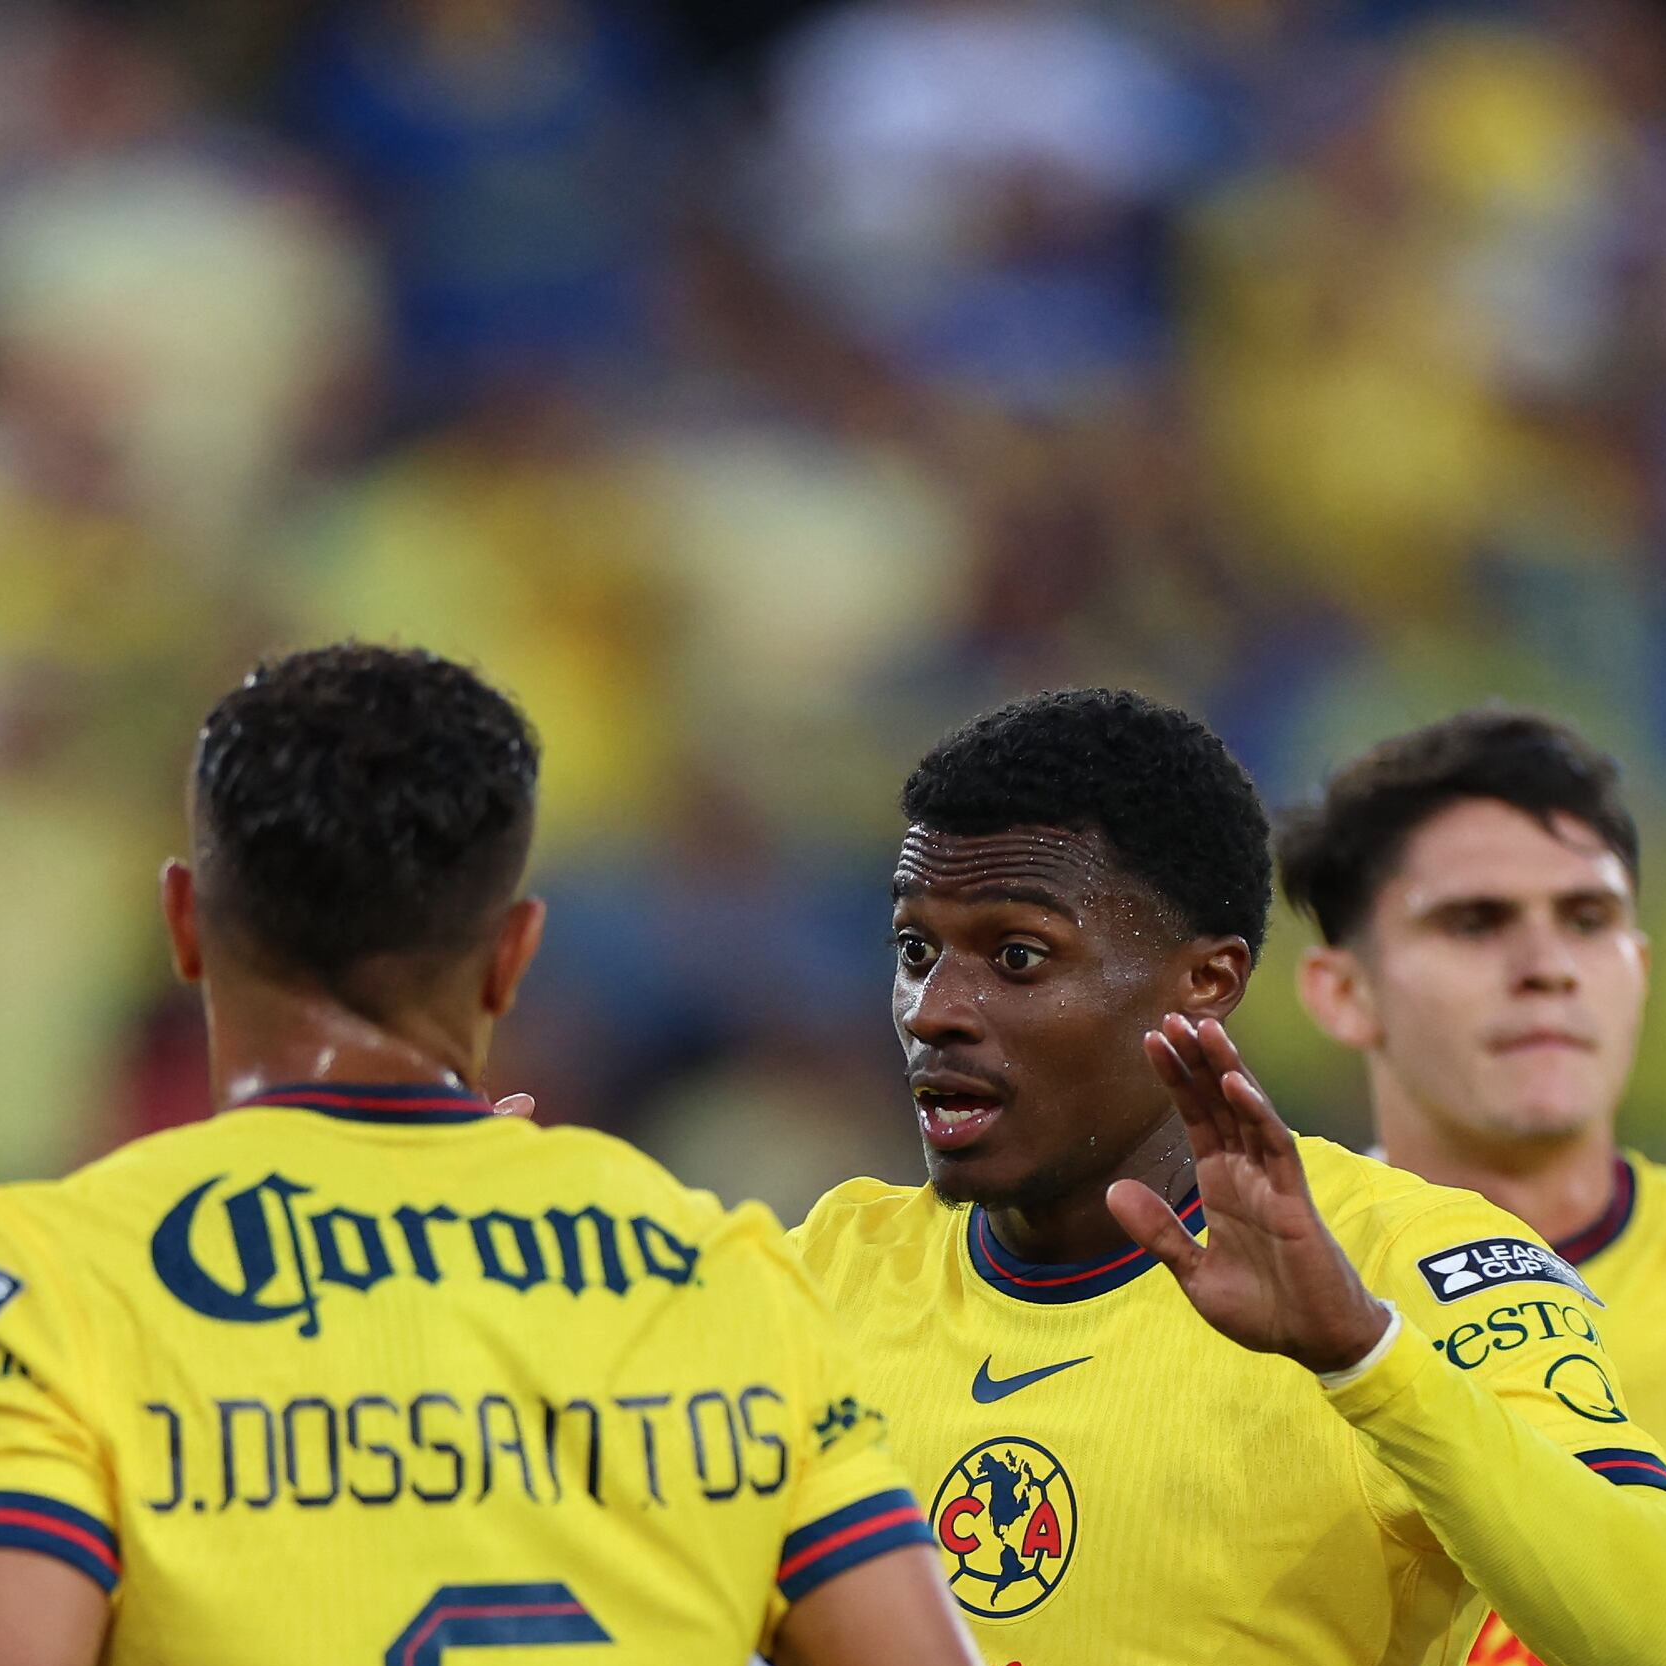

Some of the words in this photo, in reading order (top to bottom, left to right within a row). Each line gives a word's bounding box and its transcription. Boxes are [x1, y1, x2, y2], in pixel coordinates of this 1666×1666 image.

[150, 1170, 703, 1338] Corona
[1482, 1260, 1542, 1278] CUP
[142, 1384, 787, 1513] J.DOSSANTOS
